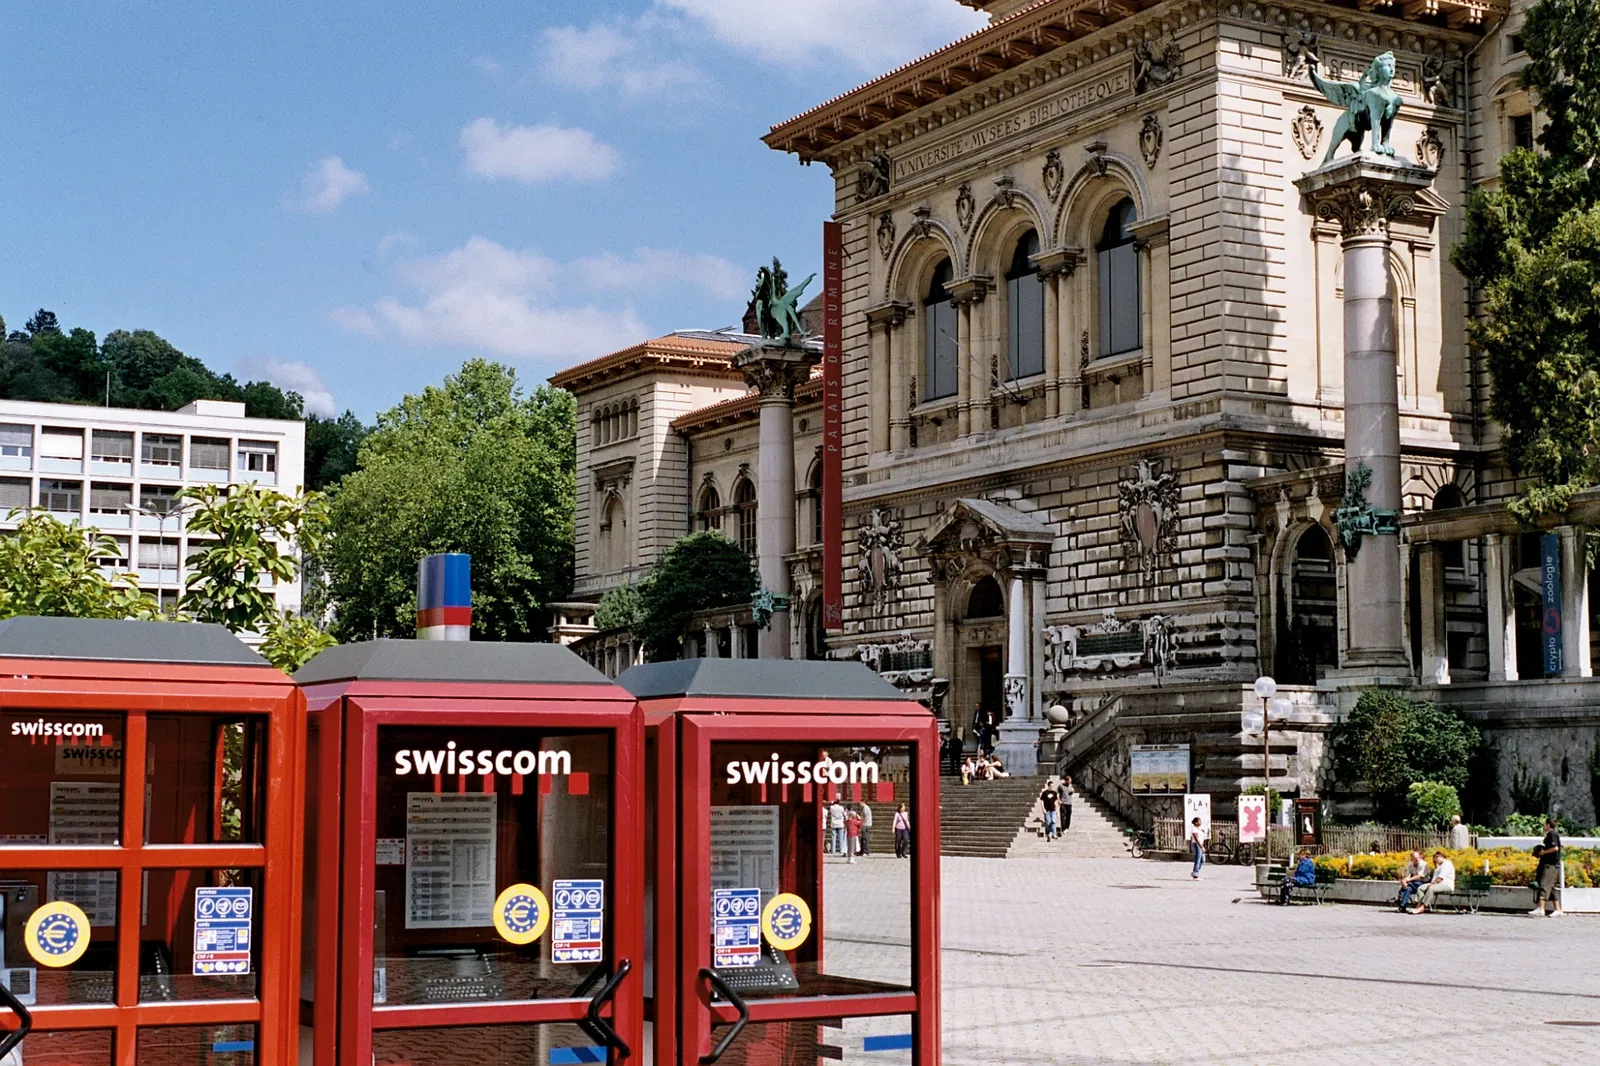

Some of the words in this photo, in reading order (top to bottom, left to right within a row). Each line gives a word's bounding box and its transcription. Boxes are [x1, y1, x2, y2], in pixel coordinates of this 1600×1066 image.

[1029, 75, 1124, 126] BIBLIOTHEQVE
[828, 247, 839, 326] RUMINE
[828, 341, 839, 363] DE
[828, 379, 839, 452] PALAIS
[1544, 556, 1556, 603] zoologie
[1548, 637, 1558, 671] crypto
[11, 718, 104, 736] swisscom
[63, 745, 122, 760] swissco
[394, 740, 572, 776] swisscom
[726, 752, 879, 785] swisscom
